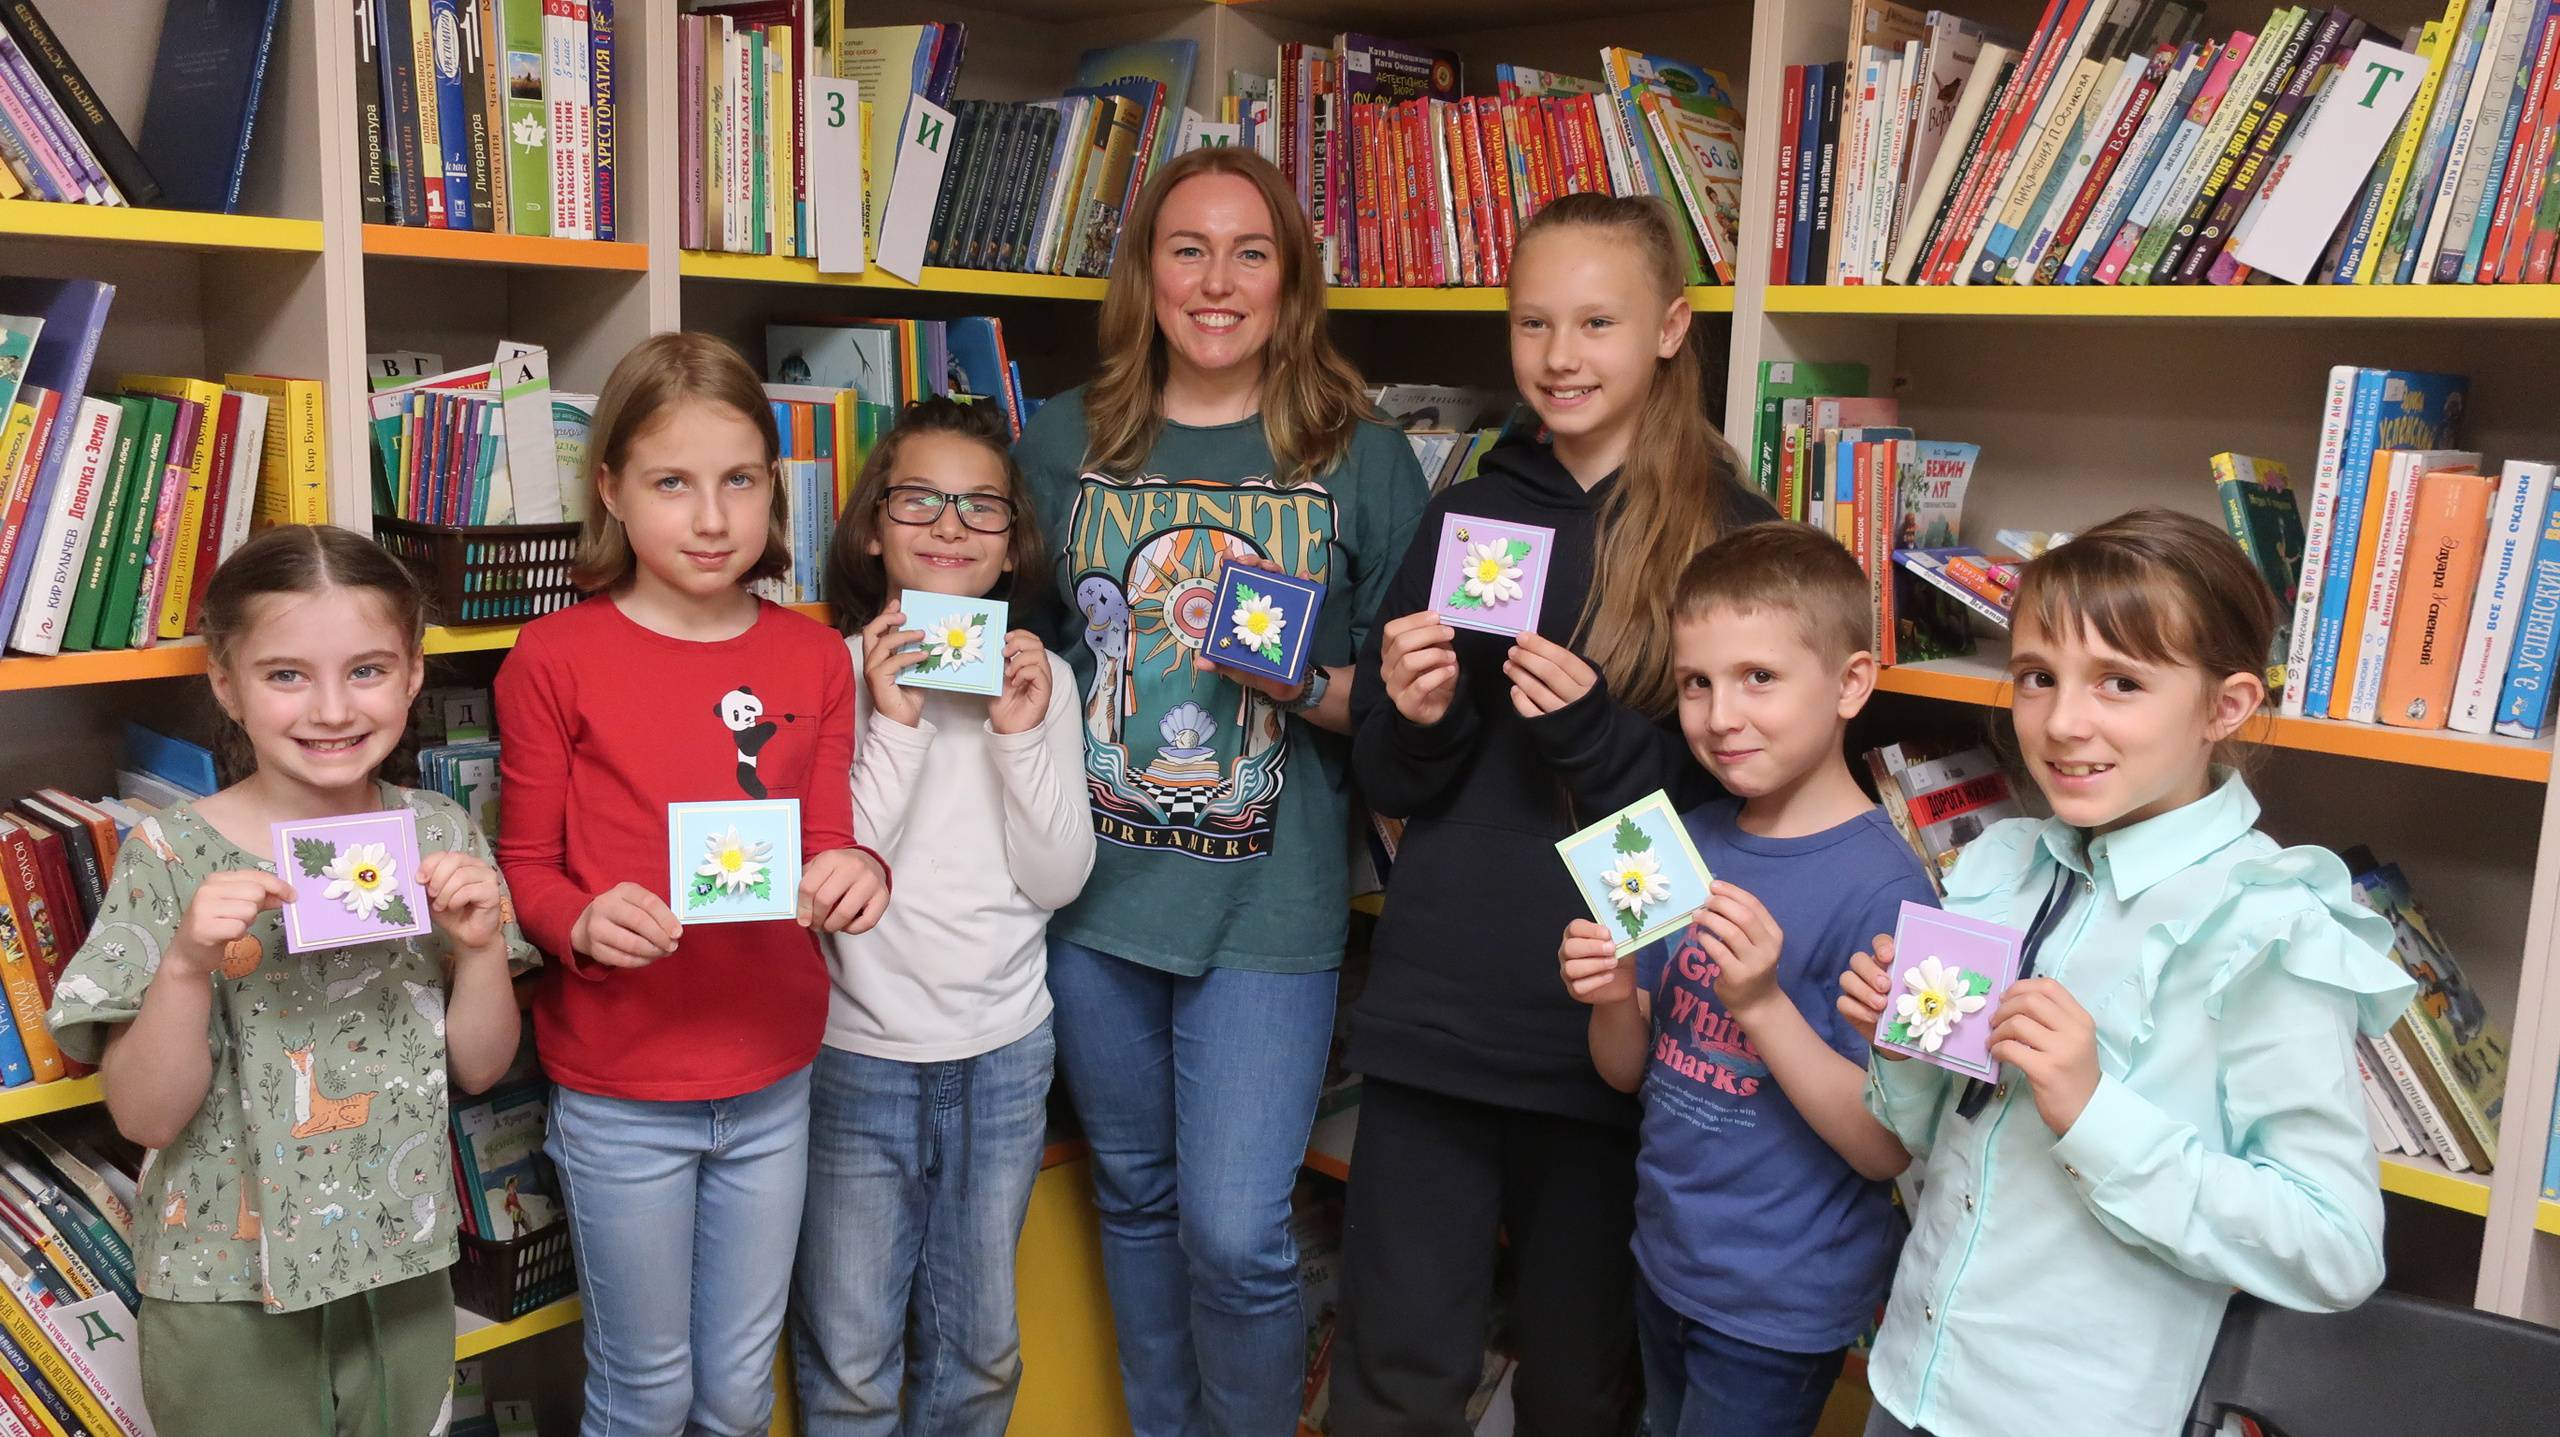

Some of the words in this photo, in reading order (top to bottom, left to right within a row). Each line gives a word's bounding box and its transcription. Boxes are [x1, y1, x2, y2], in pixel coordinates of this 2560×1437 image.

[12, 1, 66, 72] АСТАФЬЕВ
[422, 31, 431, 68] ЧТЕНИЯ
[2294, 18, 2314, 43] АННА
[2320, 20, 2339, 44] АННА
[18, 61, 52, 106] тропами
[416, 40, 427, 102] БИБЛИОТЕКА
[1916, 47, 1929, 83] Николай
[2261, 40, 2301, 96] СТАРОБИНЕЦ
[2287, 42, 2327, 99] СТАРОБИНЕЦ
[2357, 62, 2404, 108] Т
[61, 70, 103, 124] ВИКТОР
[399, 80, 409, 112] Часть
[425, 71, 438, 144] ВНЕКЛАССНОГО
[488, 73, 497, 107] Часть
[595, 48, 612, 169] ХРЕСТОМАТИЯ
[827, 92, 845, 127] З
[1910, 84, 1922, 120] Сладков
[2251, 98, 2267, 113] В
[2296, 103, 2323, 139] Дмитрий
[2318, 74, 2340, 104] Суслин
[421, 105, 430, 144] ПОЛНАЯ
[525, 124, 533, 140] 7
[554, 100, 562, 143] ЧТЕНИЕ
[565, 100, 573, 143] ЧТЕНИЕ
[580, 104, 589, 146] ЧТЕНИЕ
[916, 112, 944, 153] И
[1614, 97, 1636, 147] МАЯКОВСКИЙ
[1889, 128, 1902, 167] ЛЕСНЫЕ
[1896, 87, 1908, 125] СКАЗКИ
[2115, 86, 2151, 139] СОТНИКОВ
[2255, 109, 2288, 152] КОГТИ
[28, 104, 76, 169] Тараканьими
[48, 105, 95, 170] Тараканьими
[364, 104, 382, 185] Литература
[471, 113, 487, 192] Литература
[1947, 170, 1963, 196] ЧТОБЫ
[1960, 154, 1971, 169] ВСЕ
[1967, 131, 1982, 154] БЫЛИ
[1977, 84, 2004, 131] СЧАСТЛИВЫ
[2224, 110, 2260, 158] ЛОГОВЕ
[2452, 117, 2475, 157] РОСТИК
[403, 125, 418, 216] ХРЕСТОМАТИЯ
[1780, 145, 1791, 168] ЕСЛИ
[1818, 143, 1833, 193] ПОХИЩЕНИЕ
[1871, 185, 1884, 228] ЛЕСНОЙ
[1878, 118, 1892, 179] КАЛЕНДАРЬ
[2201, 156, 2233, 199] ВОЛКА
[2232, 150, 2264, 193] ГНЕВА
[2522, 167, 2541, 207] Алексей
[2533, 125, 2551, 166] Толстой
[427, 190, 443, 212] 1
[556, 148, 565, 227] ВНЕКЛАССНОЕ
[566, 148, 575, 226] ВНЕКЛАССНОЕ
[582, 152, 592, 230] ВНЕКЛАССНОЕ
[599, 171, 610, 224] ПОЛНАЯ
[1778, 179, 1788, 196] ВАС
[2440, 168, 2459, 198] КЕША
[2493, 195, 2511, 227] Ирина
[2502, 142, 2526, 194] Токмакова
[1777, 199, 1786, 214] НЕТ
[1815, 196, 1828, 231] ON-LINE
[2348, 180, 2388, 246] Тарловский
[1774, 217, 1785, 248] СОБАКИ
[2160, 250, 2177, 274] CLEVER
[2184, 252, 2202, 275] CLEVER
[2339, 246, 2363, 280] Марк
[383, 359, 400, 376] В
[414, 358, 428, 375] Г
[518, 364, 534, 384] А
[51, 424, 71, 463] БАЛЛАДА
[67, 362, 90, 413] МАЛЕНЬКОМ
[82, 326, 100, 362] БУКСИРЕ
[2330, 378, 2347, 418] АНФИСУ
[33, 417, 55, 460] СТАКАНЧИКАХ
[85, 412, 110, 454] Земли
[303, 393, 314, 442] Булычев
[191, 448, 205, 474] Кир
[304, 448, 316, 472] Кир
[1761, 441, 1773, 459] Лев
[1926, 460, 1966, 478] БЕЖИН
[2321, 422, 2339, 478] ОБЕЗЬЯНКУ
[12, 463, 32, 501] МОРОЖЕНОЕ
[67, 464, 98, 520] Девочка
[1782, 477, 1792, 519] ССКАЗЫ
[1932, 481, 1951, 498] ЛУГ
[2315, 492, 2328, 518] ВЕРУ
[0, 522, 18, 554] БОТЕВА
[52, 527, 79, 583] БУЛЫЧЕВ
[174, 498, 197, 571] ДИНОЗАВРОВ
[1074, 486, 1328, 584] INFINITE
[2307, 521, 2323, 564] ДЕВОЧКУ
[2303, 567, 2316, 587] ПРО
[2429, 534, 2460, 590] Эдуард
[2475, 636, 2493, 684] Успенский
[2485, 603, 2501, 630] ВСЕ
[2493, 538, 2516, 599] ЛУЧШИЕ
[2507, 474, 2530, 533] СКАЗКИ
[46, 584, 63, 609] КИР
[170, 574, 185, 603] ДЕТИ
[2290, 607, 2310, 664] Успенский
[2416, 592, 2448, 667] Успенский
[2518, 559, 2560, 672] УСПЕНСКИЙ
[2514, 674, 2540, 691] Э.
[458, 705, 476, 725] Д
[1927, 788, 1967, 819] ДОРОГА
[1100, 816, 1240, 857] DREAMER
[14, 841, 34, 891] ВОЛКОВ
[1655, 1033, 1760, 1097] Sharks
[2430, 1127, 2457, 1163] САША
[21, 1292, 48, 1322] ЗЕРКАЛ
[9, 1316, 43, 1353] КРИВЫХ
[45, 1321, 73, 1353] КРИВЫХ
[76, 1310, 125, 1351] Д
[33, 1376, 55, 1403] Громова
[37, 1350, 85, 1404] КОРОЛЕВСТВО
[69, 1351, 112, 1400] КОРОЛЕВСТВО
[457, 1368, 471, 1386] У
[51, 1399, 70, 1421] Ольга
